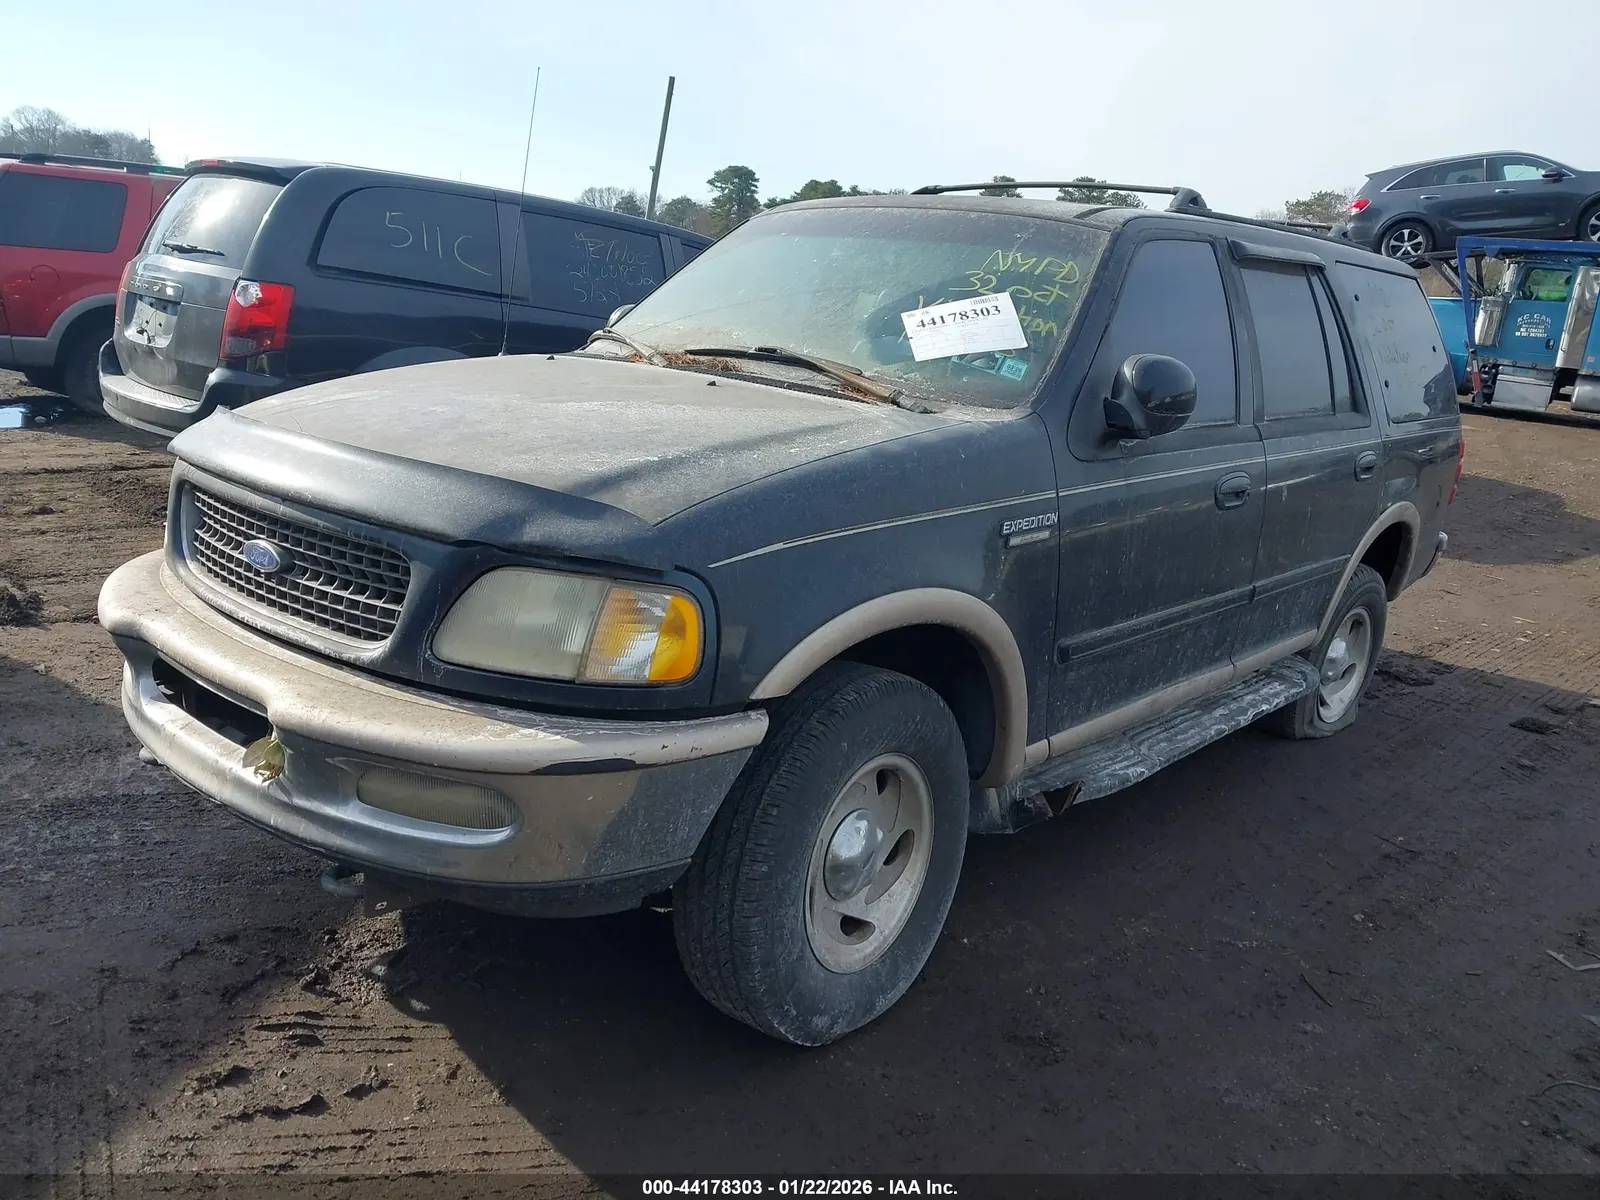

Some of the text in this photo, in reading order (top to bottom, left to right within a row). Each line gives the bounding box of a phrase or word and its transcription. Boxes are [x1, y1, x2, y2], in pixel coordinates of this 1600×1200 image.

[916, 305, 1002, 329] 44178303
[1003, 512, 1058, 534] EXPEDITION
[250, 546, 269, 566] Ford
